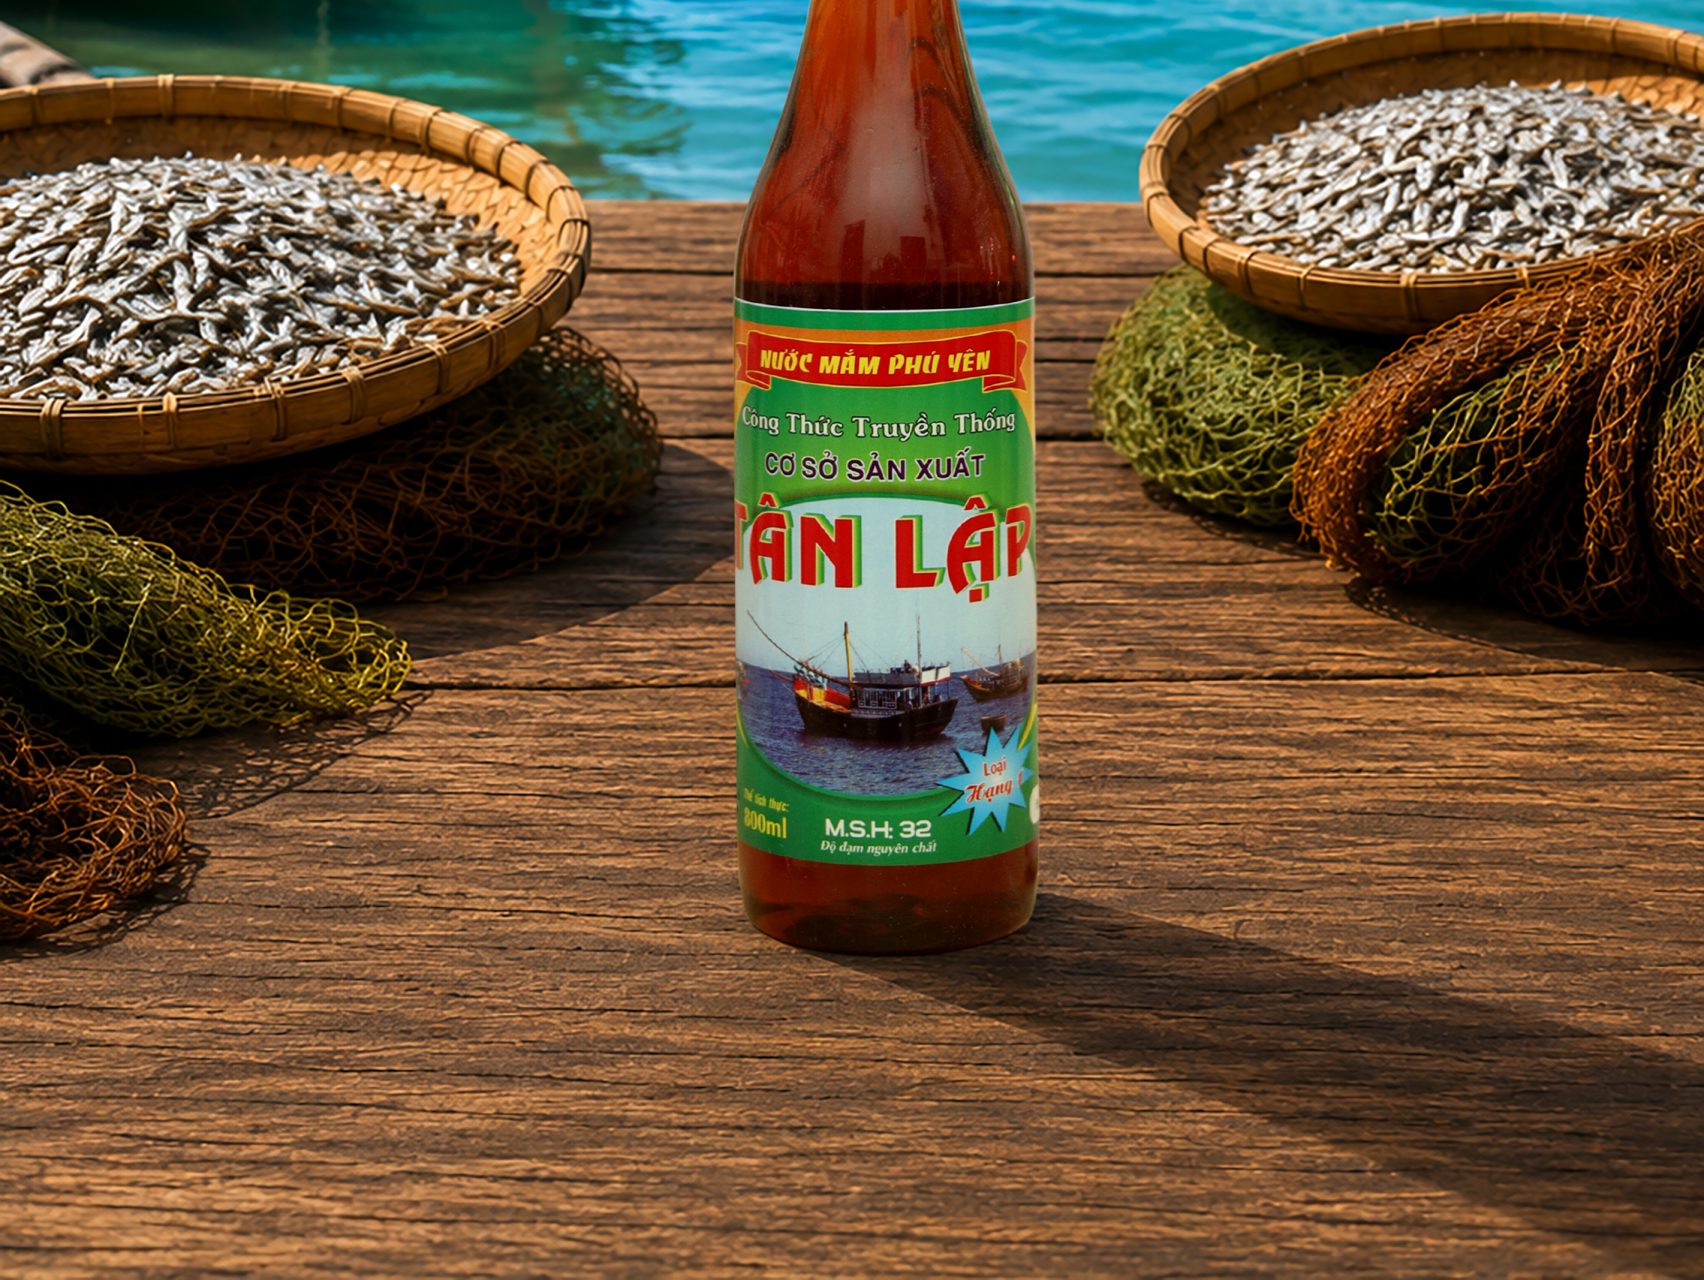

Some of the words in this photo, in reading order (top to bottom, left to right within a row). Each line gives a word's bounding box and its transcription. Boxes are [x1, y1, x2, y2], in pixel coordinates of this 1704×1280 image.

[760, 348, 813, 373] NƯỚC
[818, 348, 880, 375] MẮM
[888, 350, 940, 375] PHÚ
[948, 348, 991, 373] YÊN
[742, 406, 779, 435] Công
[785, 412, 843, 436] Thức
[851, 412, 946, 441] Truyền
[953, 407, 1016, 435] Thống
[764, 452, 796, 476] CƠ
[801, 449, 838, 481] SỞ
[846, 451, 907, 483] SẢN
[915, 446, 986, 482] XUẤT
[895, 493, 1032, 604] LẬP
[983, 754, 1007, 777] Loại
[965, 780, 1013, 804] Hạng
[743, 806, 788, 839] 800ml
[825, 818, 893, 839] M.S.H:
[899, 819, 932, 838] 32
[820, 840, 837, 854] Độ
[866, 842, 909, 857] nguyên
[911, 839, 937, 854] chất
